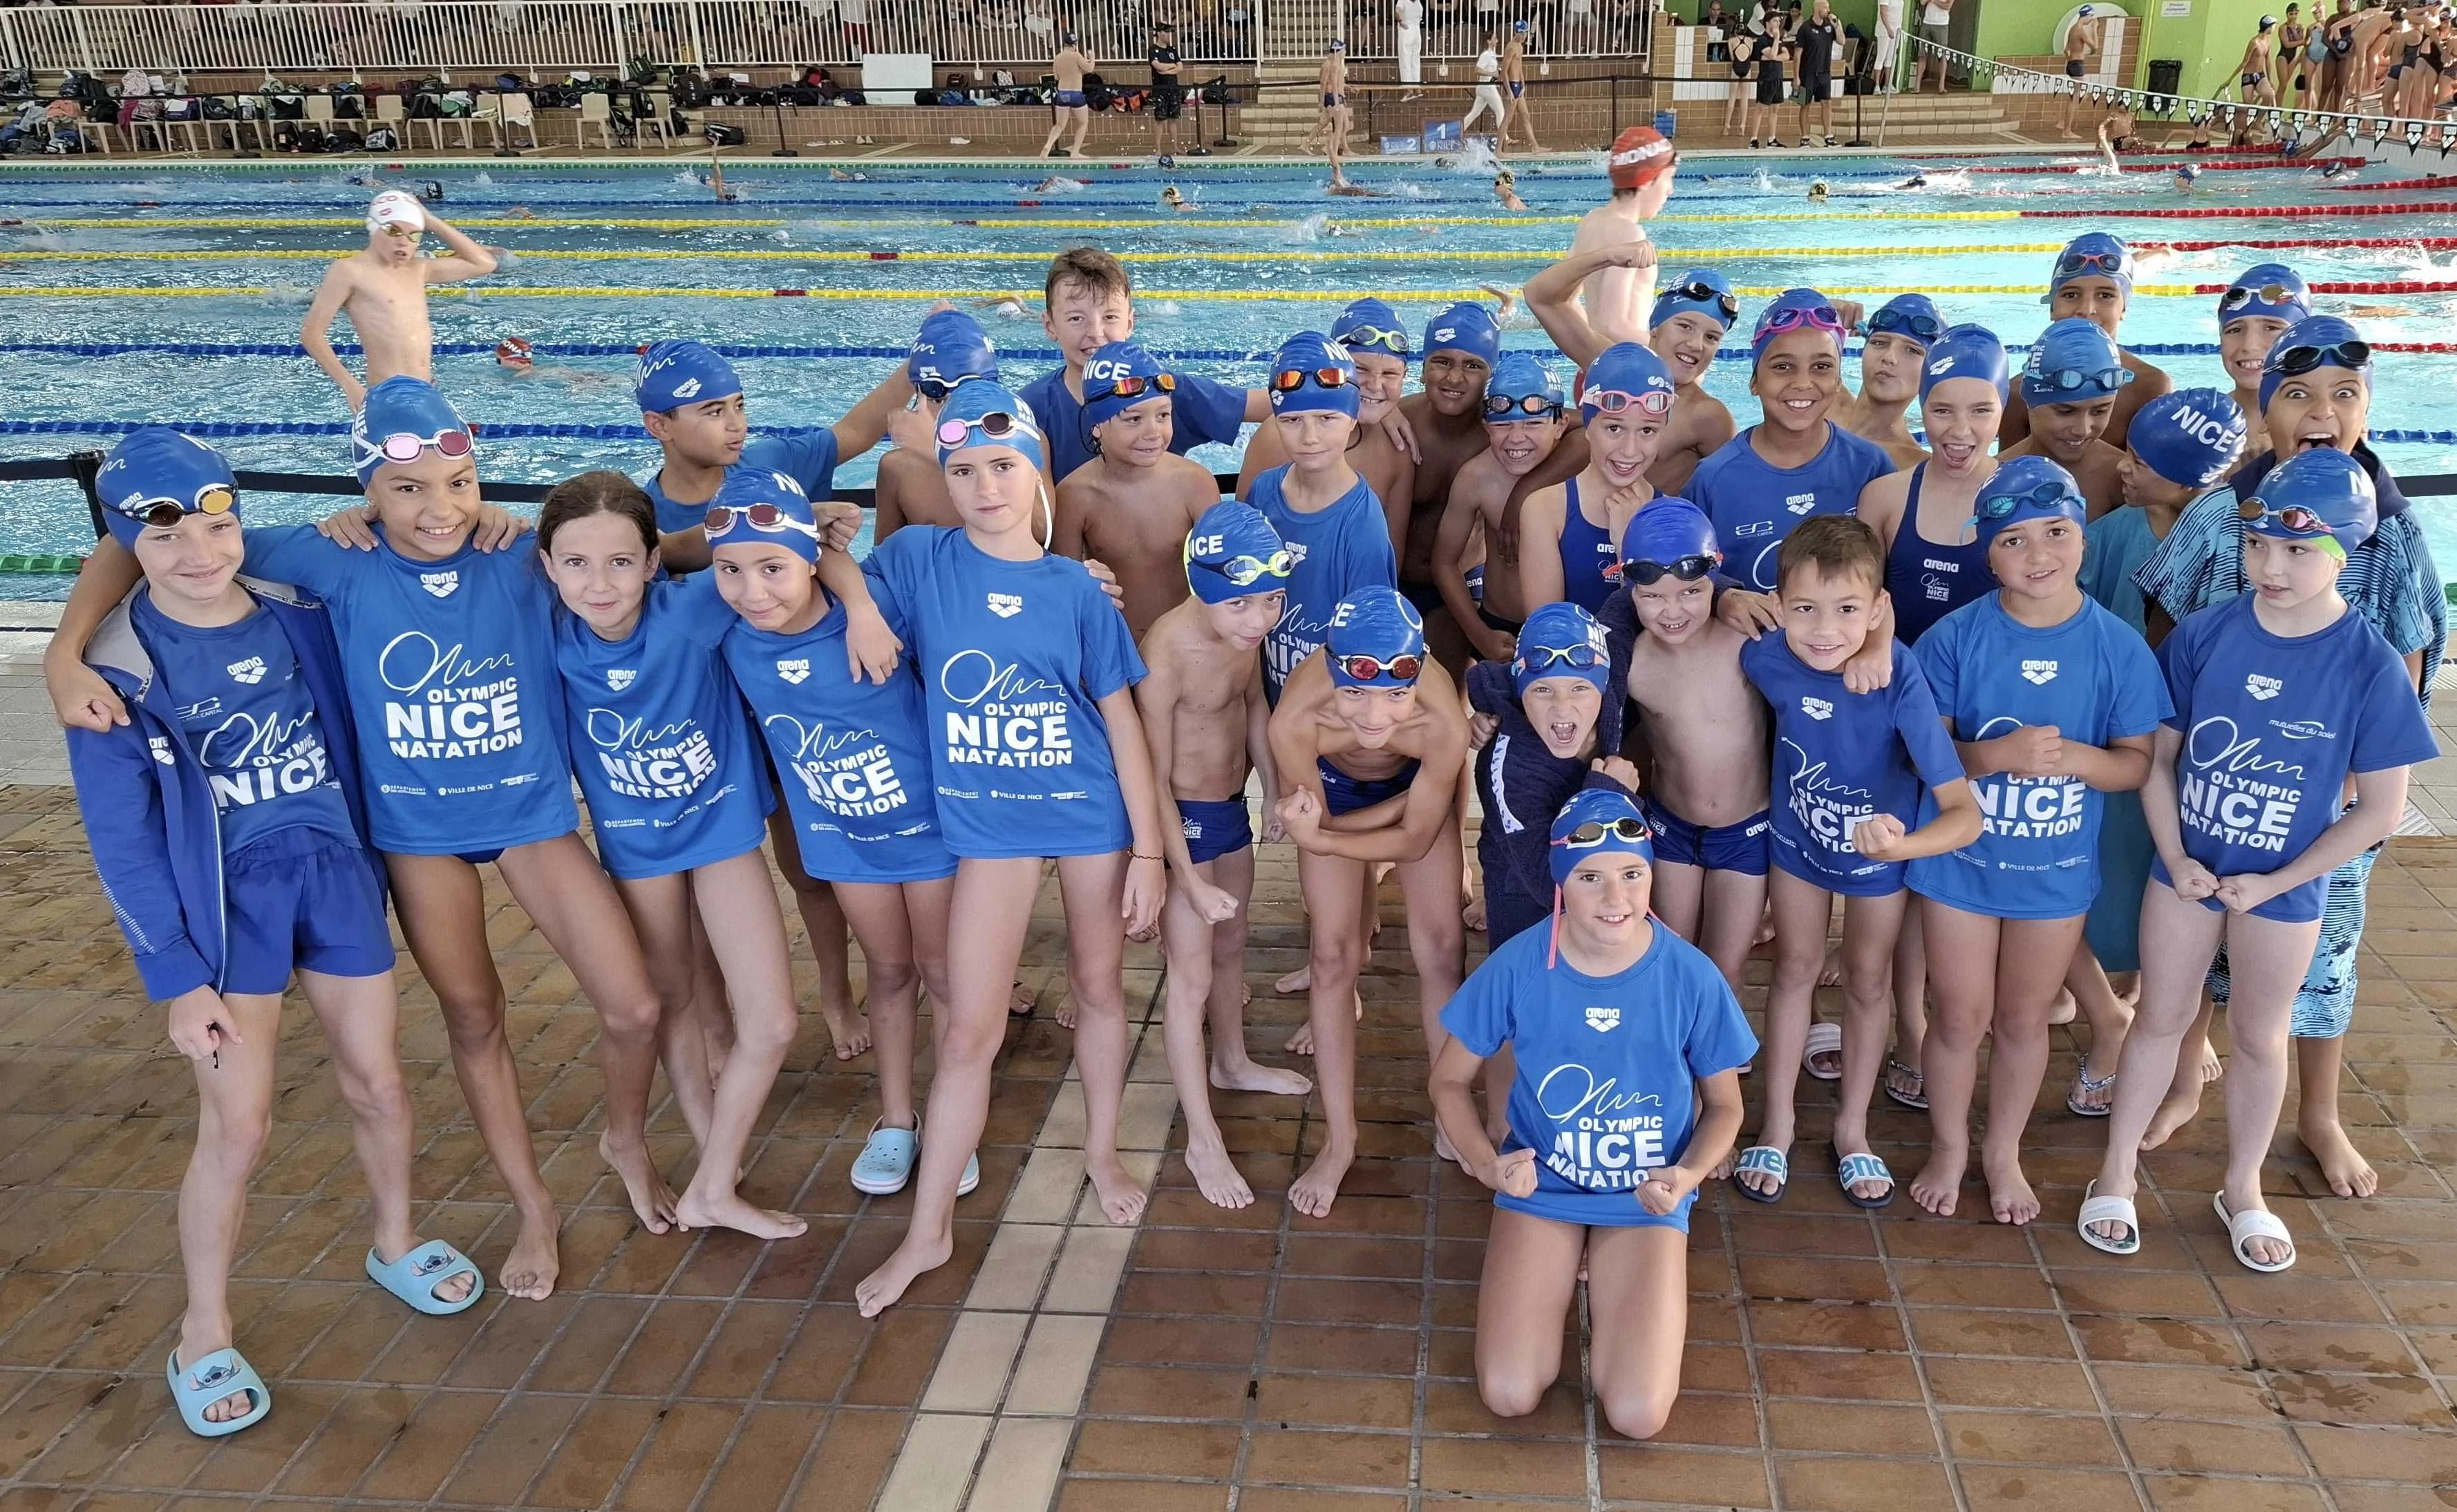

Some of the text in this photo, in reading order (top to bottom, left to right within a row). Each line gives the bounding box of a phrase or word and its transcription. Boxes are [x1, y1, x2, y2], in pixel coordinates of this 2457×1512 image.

[1438, 123, 1446, 139] 1
[1407, 139, 1416, 151] 2
[1322, 341, 1355, 363] NI
[1082, 359, 1132, 381] NICE
[2171, 405, 2237, 453] NICE
[772, 473, 806, 497] NI
[1786, 493, 1815, 505] arena
[1190, 534, 1223, 558] ICE
[1285, 541, 1308, 554] arena
[1597, 543, 1616, 554] are
[1923, 558, 1959, 573] arena
[420, 571, 459, 585] arena
[1466, 577, 1483, 587] ena
[987, 593, 1022, 607] arena
[1265, 635, 1306, 673] NIC
[1279, 633, 1321, 654] OLYMP
[227, 656, 265, 676] arena
[608, 670, 637, 680] arena
[777, 659, 809, 671] arena
[2021, 660, 2058, 671] arena
[427, 677, 518, 703] OLYMPIC
[2248, 674, 2283, 690] arena
[983, 701, 1067, 717] OLYMPIC
[1802, 696, 1834, 712] arena
[385, 692, 521, 740] NICE
[2268, 719, 2306, 733] mutuelles
[946, 712, 1072, 750] NICE
[149, 736, 169, 749] are
[389, 728, 523, 758] NATATION
[625, 730, 706, 762] OLYMPIC
[599, 739, 715, 786] NICE
[807, 744, 888, 773] OLYMPIC
[948, 746, 1073, 768] NATATION
[209, 746, 326, 808] NICE
[610, 759, 717, 799] NATATION
[791, 757, 901, 802] NICE
[2211, 771, 2301, 803] OLYMPIC
[1797, 787, 1874, 815] OLYMPIC
[1968, 779, 2086, 820] NICE
[2182, 772, 2297, 835] NICE
[1983, 815, 2082, 838] ATATION
[2181, 805, 2286, 852] NATATION
[1585, 1008, 1620, 1019] arena
[1578, 1115, 1664, 1132] OLYMPIC
[1554, 1130, 1666, 1168] NICE
[1546, 1153, 1650, 1187] NATATIO
[1738, 1149, 1782, 1173] are
[1840, 1155, 1892, 1184] ena
